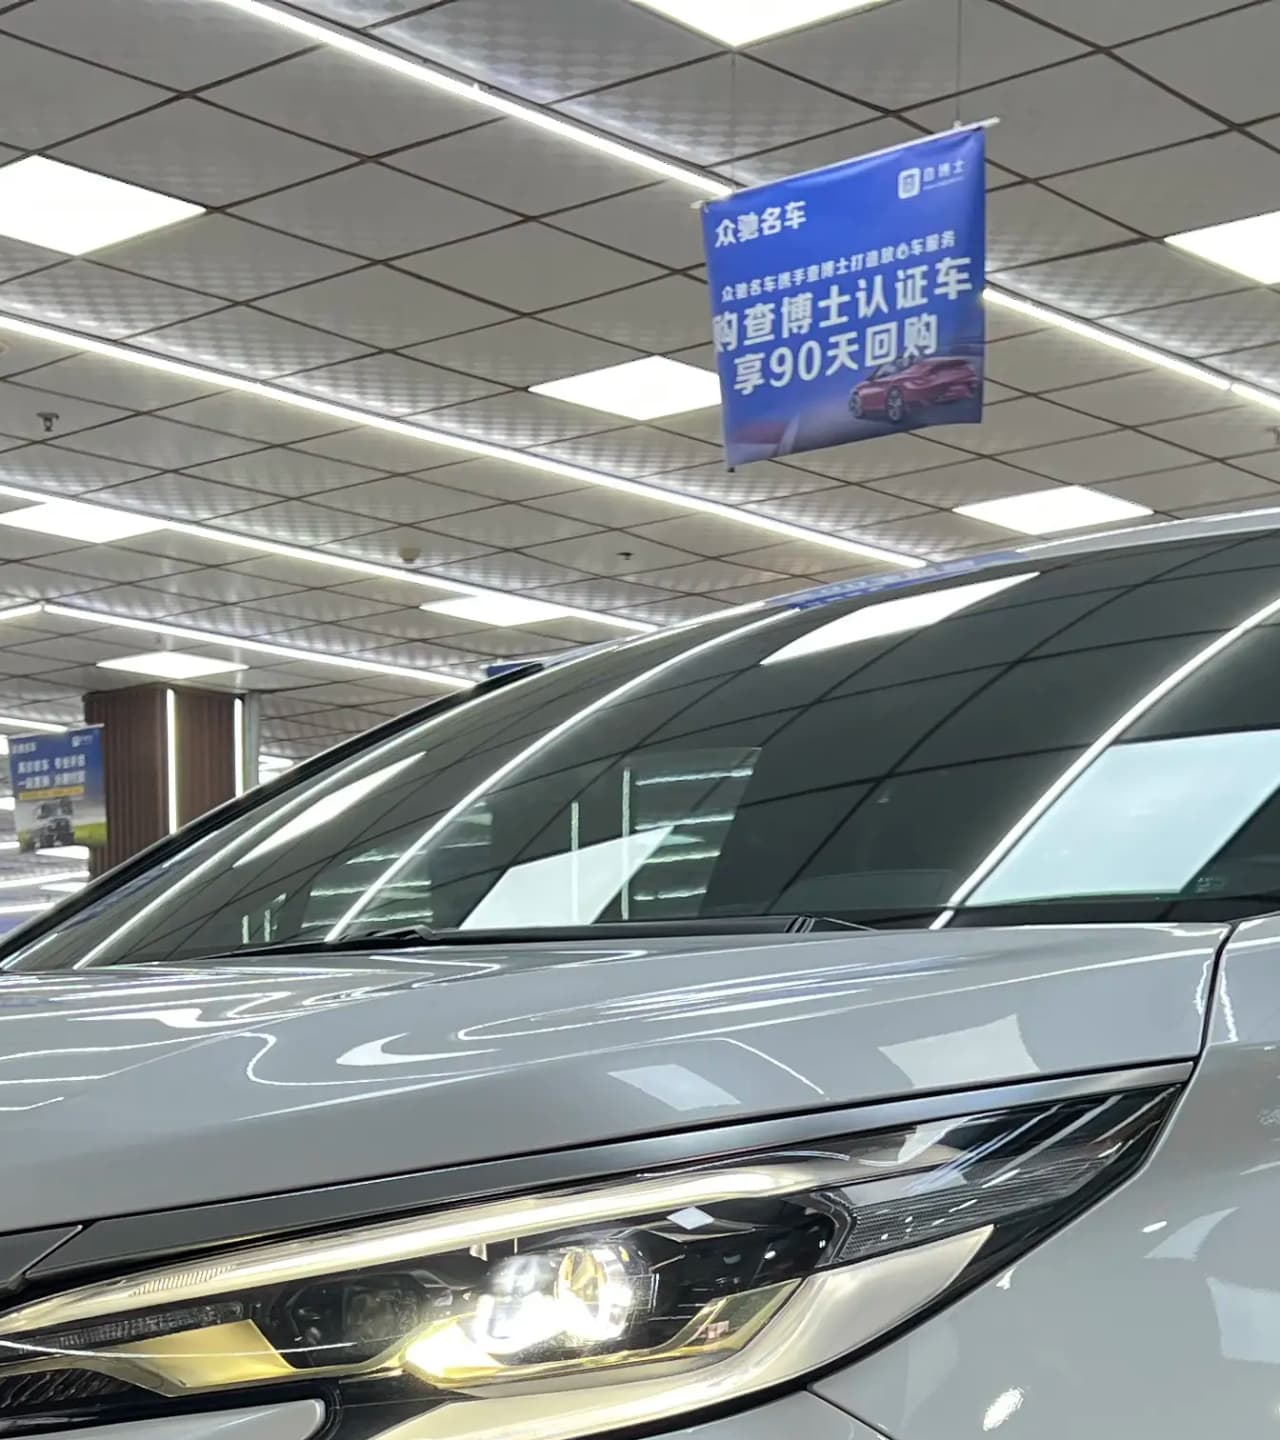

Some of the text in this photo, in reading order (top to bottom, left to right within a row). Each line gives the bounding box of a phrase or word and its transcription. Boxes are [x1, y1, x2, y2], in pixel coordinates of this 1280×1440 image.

[714, 200, 807, 248] 众驰名车
[713, 256, 973, 353] 购查博士认证车
[733, 313, 938, 396] 享90天回购
